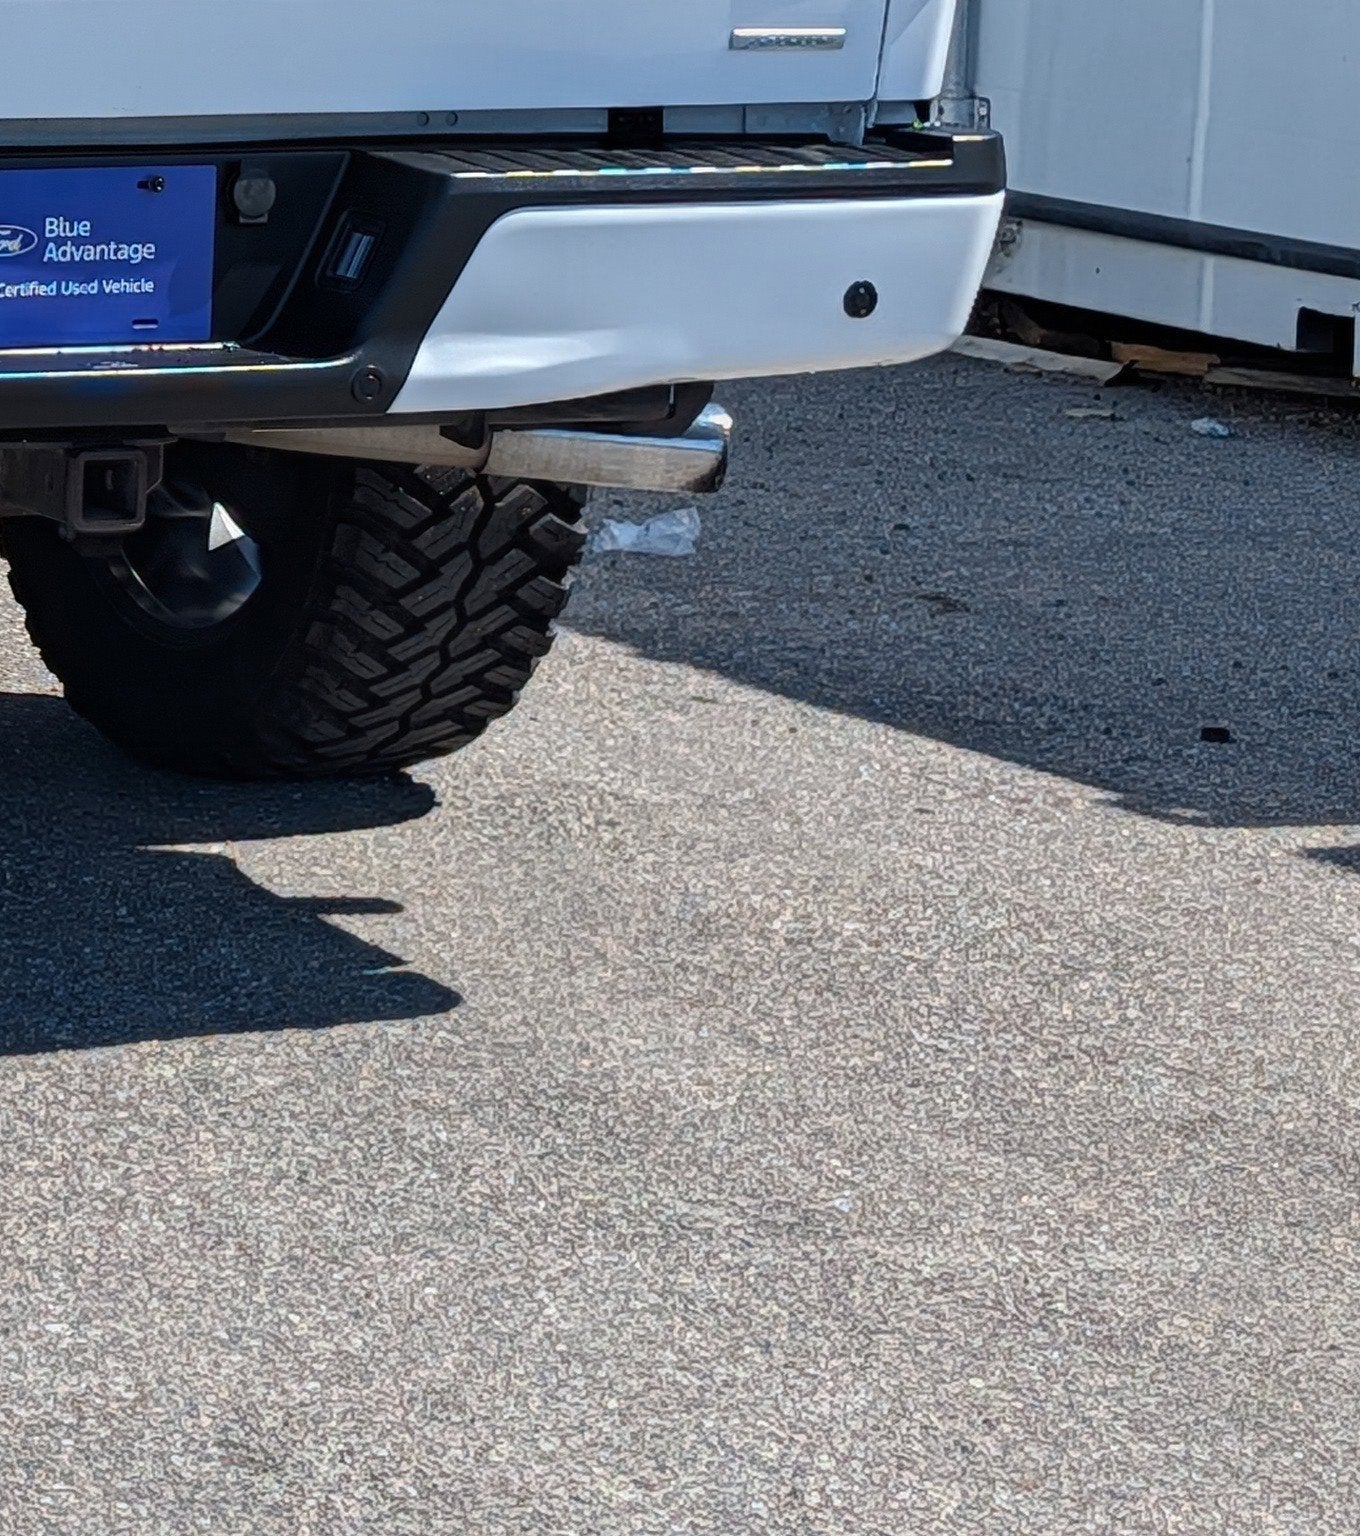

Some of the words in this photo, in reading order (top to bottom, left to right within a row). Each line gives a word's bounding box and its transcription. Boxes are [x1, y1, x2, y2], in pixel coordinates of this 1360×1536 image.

[44, 216, 91, 238] Blue
[43, 240, 156, 264] Advantage
[61, 279, 99, 296] Used
[102, 277, 155, 295] Vehicle
